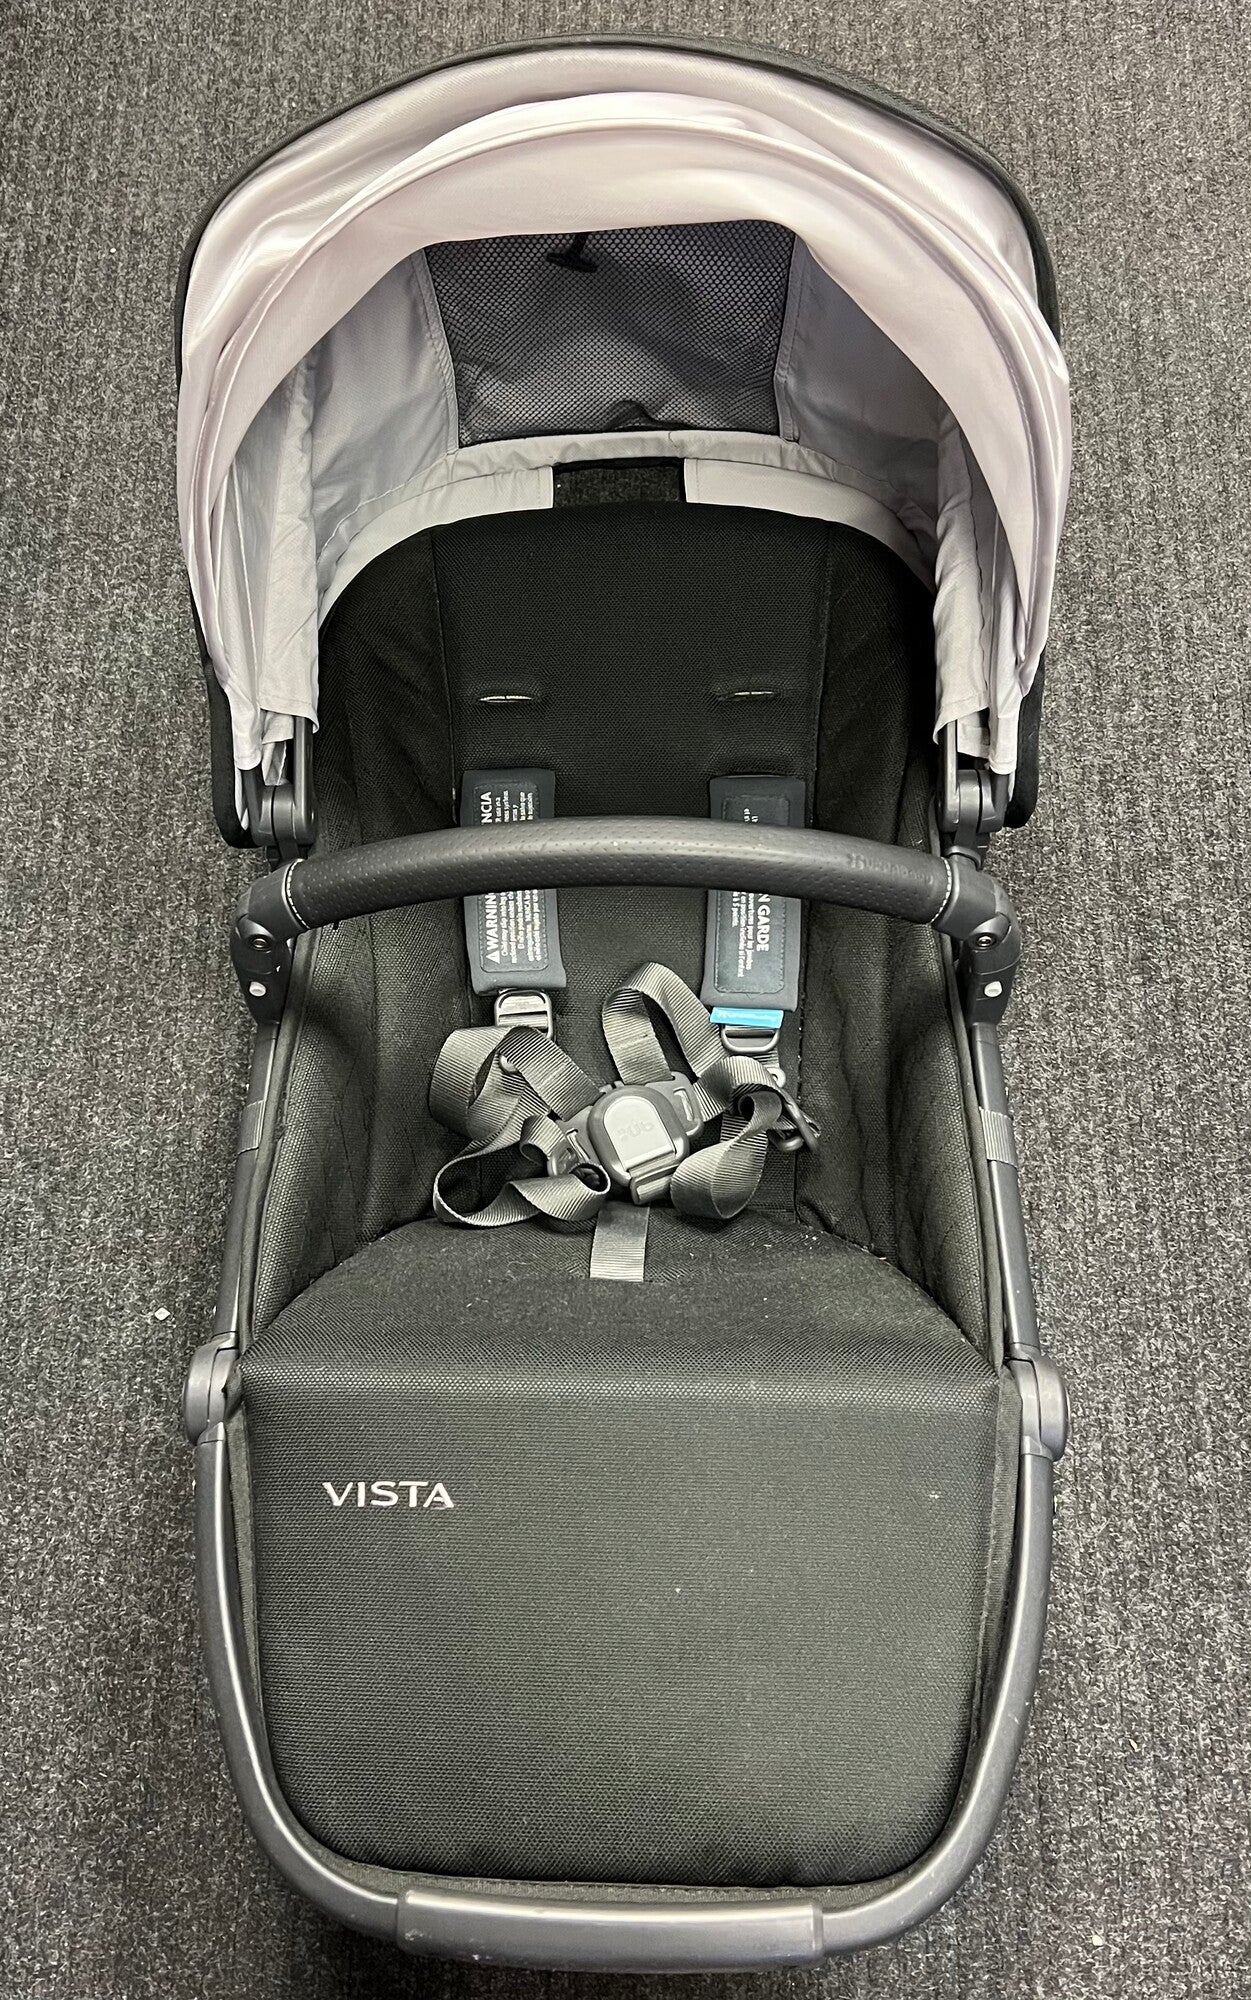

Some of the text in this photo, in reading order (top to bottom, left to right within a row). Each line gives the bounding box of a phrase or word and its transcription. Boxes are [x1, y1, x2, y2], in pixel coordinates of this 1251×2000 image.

[480, 792, 492, 823] NCIA
[757, 905, 770, 951] GARDE
[322, 1481, 454, 1508] VISTA
